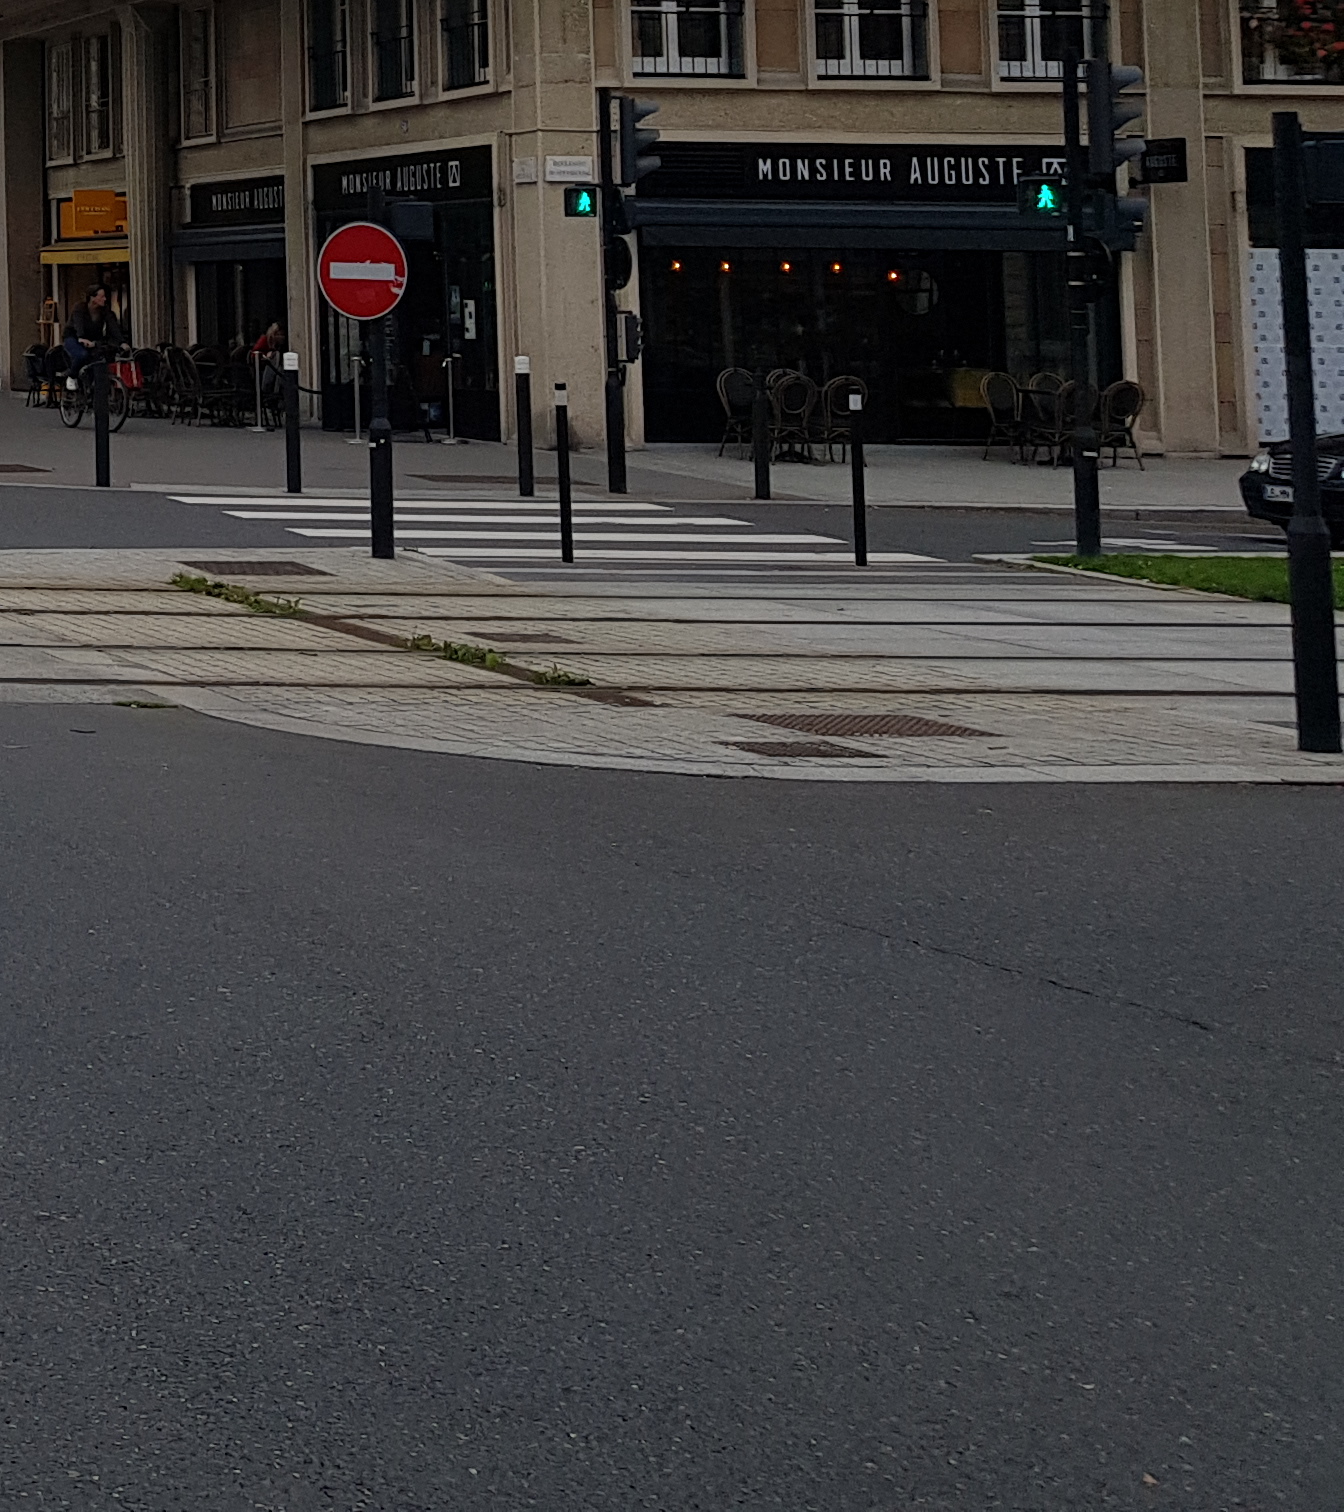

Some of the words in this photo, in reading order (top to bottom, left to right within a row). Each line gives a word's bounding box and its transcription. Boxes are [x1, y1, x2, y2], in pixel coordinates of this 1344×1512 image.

[342, 171, 391, 195] MONSIEUR
[397, 162, 442, 191] AUGUSTE
[758, 158, 891, 181] MONSIEUR
[911, 157, 1023, 185] AUGUSTE
[212, 192, 250, 210] MONSIEUR
[254, 186, 283, 209] AUGUST
